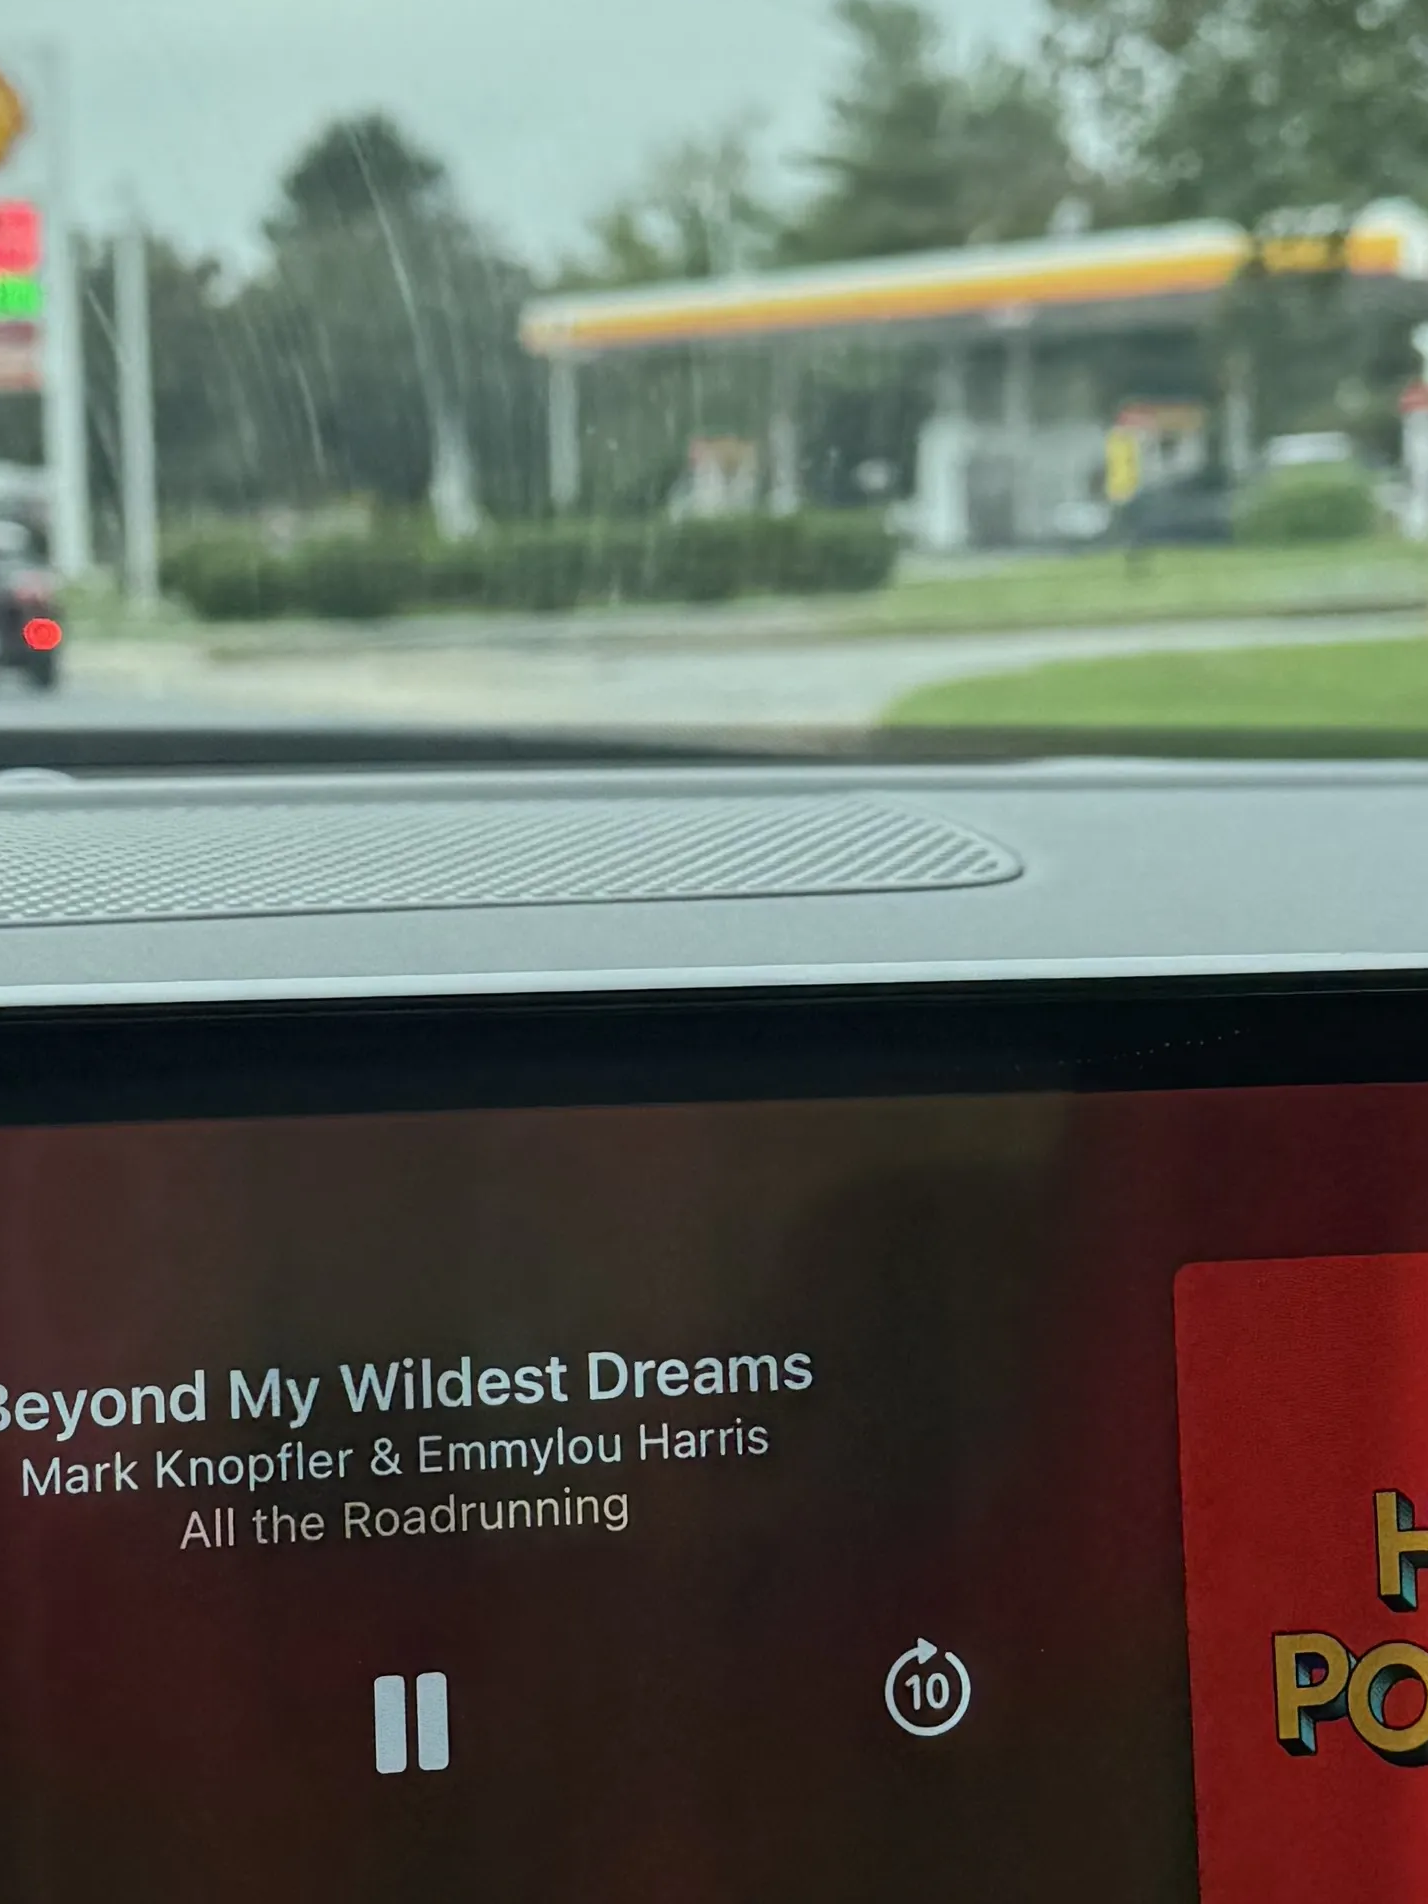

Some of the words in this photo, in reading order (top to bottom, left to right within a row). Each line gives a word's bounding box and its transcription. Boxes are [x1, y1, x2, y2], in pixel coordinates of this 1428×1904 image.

[229, 1367, 320, 1429] My
[339, 1355, 569, 1413] Wildest
[587, 1351, 813, 1401] Dreams
[22, 1451, 139, 1497] Mark
[156, 1440, 354, 1492] Knopfler
[370, 1437, 403, 1476] &
[418, 1426, 621, 1476] Emmylou
[639, 1422, 769, 1461] Harris
[179, 1507, 235, 1550] All
[251, 1504, 325, 1544] the
[344, 1486, 629, 1539] Roadrunning
[904, 1672, 950, 1711] 10
